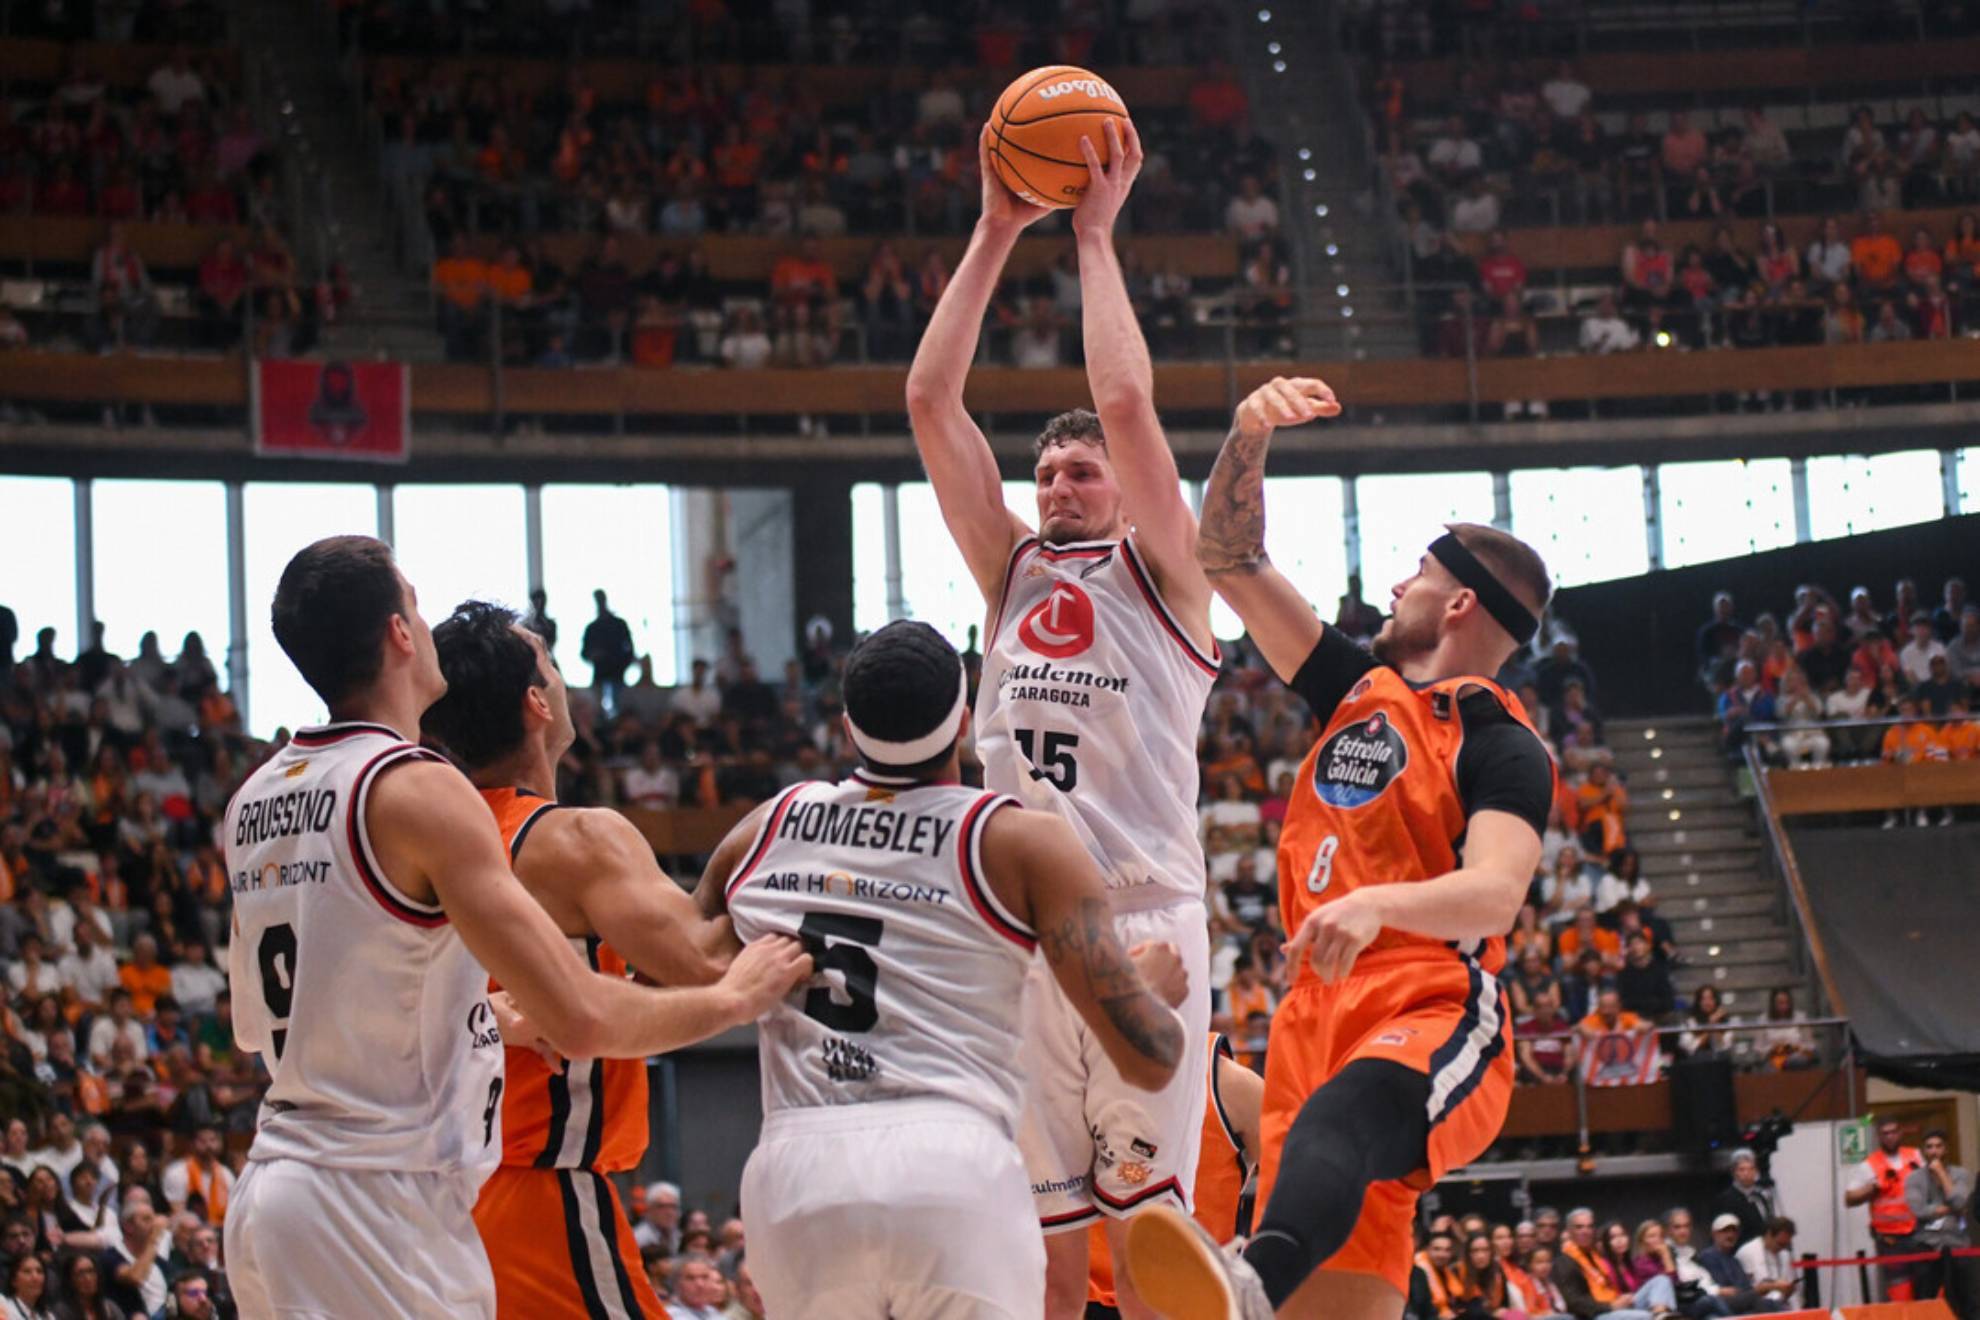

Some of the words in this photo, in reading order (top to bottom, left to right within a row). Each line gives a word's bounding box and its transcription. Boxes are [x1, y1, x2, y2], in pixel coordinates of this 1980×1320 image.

[1010, 686, 1090, 707] ZARAGOZA
[1015, 729, 1079, 792] 15
[1327, 756, 1379, 785] Galicia
[1332, 734, 1392, 763] Estrella
[236, 789, 336, 847] BRUSSINO
[779, 801, 954, 858] HOMESLEY
[764, 872, 799, 891] AIR
[807, 870, 950, 905] HORIZONT
[1308, 835, 1339, 893] 8
[798, 911, 883, 1033] 5
